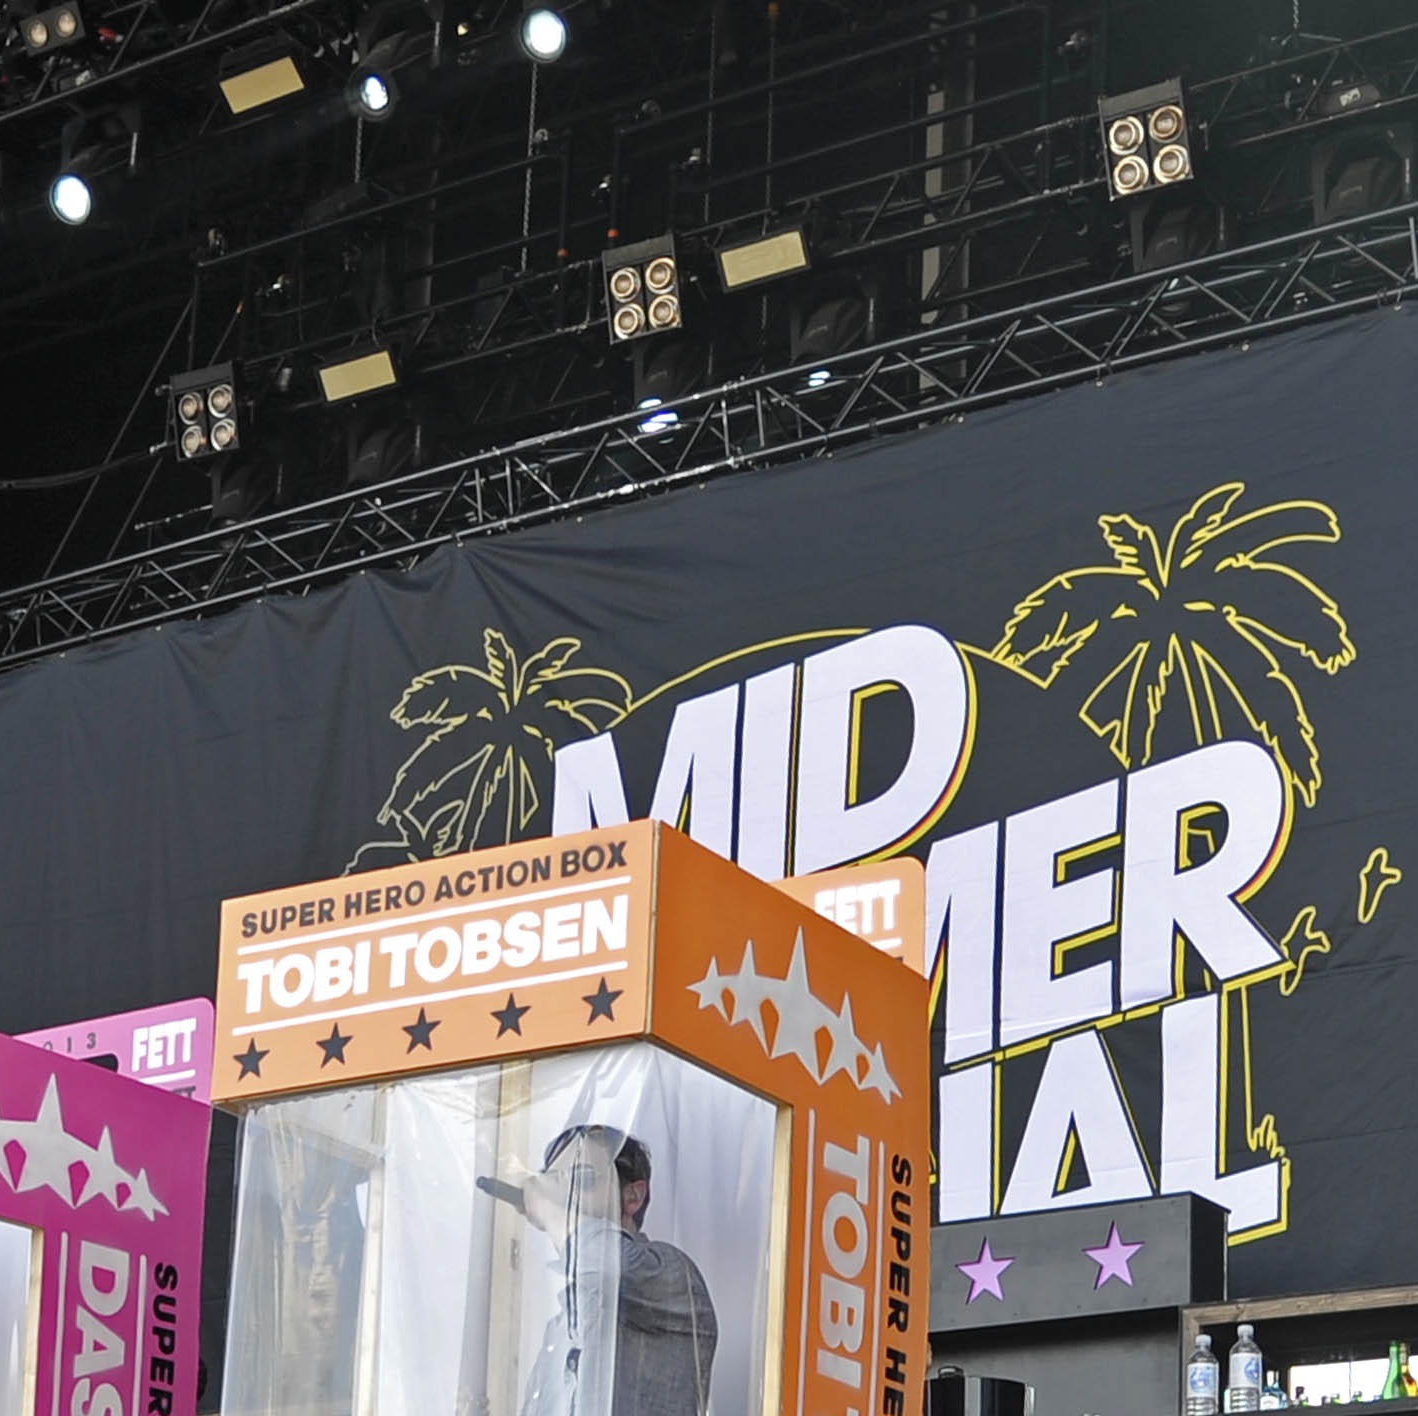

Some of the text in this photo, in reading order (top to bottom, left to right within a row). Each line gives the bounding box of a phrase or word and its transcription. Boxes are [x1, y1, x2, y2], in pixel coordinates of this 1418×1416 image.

[242, 840, 628, 939] SUPER HERO ACTION BOX
[237, 894, 629, 1014] TOBI TOBSEN
[131, 1017, 197, 1072] FETT
[816, 1133, 871, 1390] TOBI
[887, 1153, 913, 1334] SUPER
